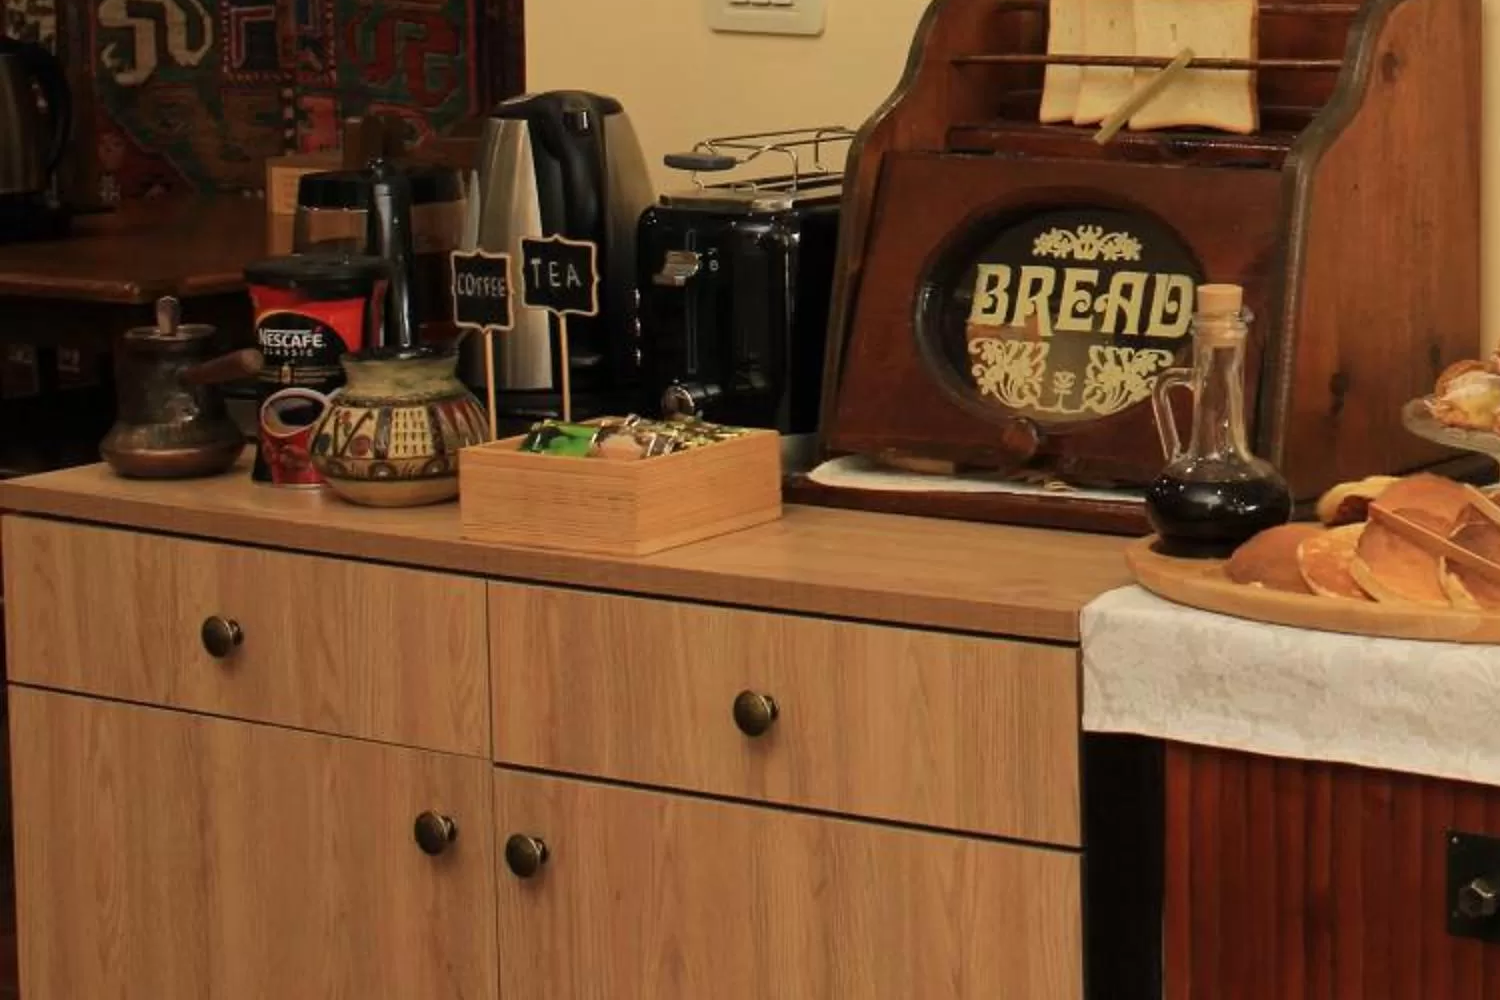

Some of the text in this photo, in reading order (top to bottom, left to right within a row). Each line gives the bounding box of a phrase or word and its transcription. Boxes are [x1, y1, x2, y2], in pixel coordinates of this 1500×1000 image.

[457, 271, 507, 297] COFFEE
[530, 257, 582, 290] TEA
[967, 263, 1195, 339] BREAD
